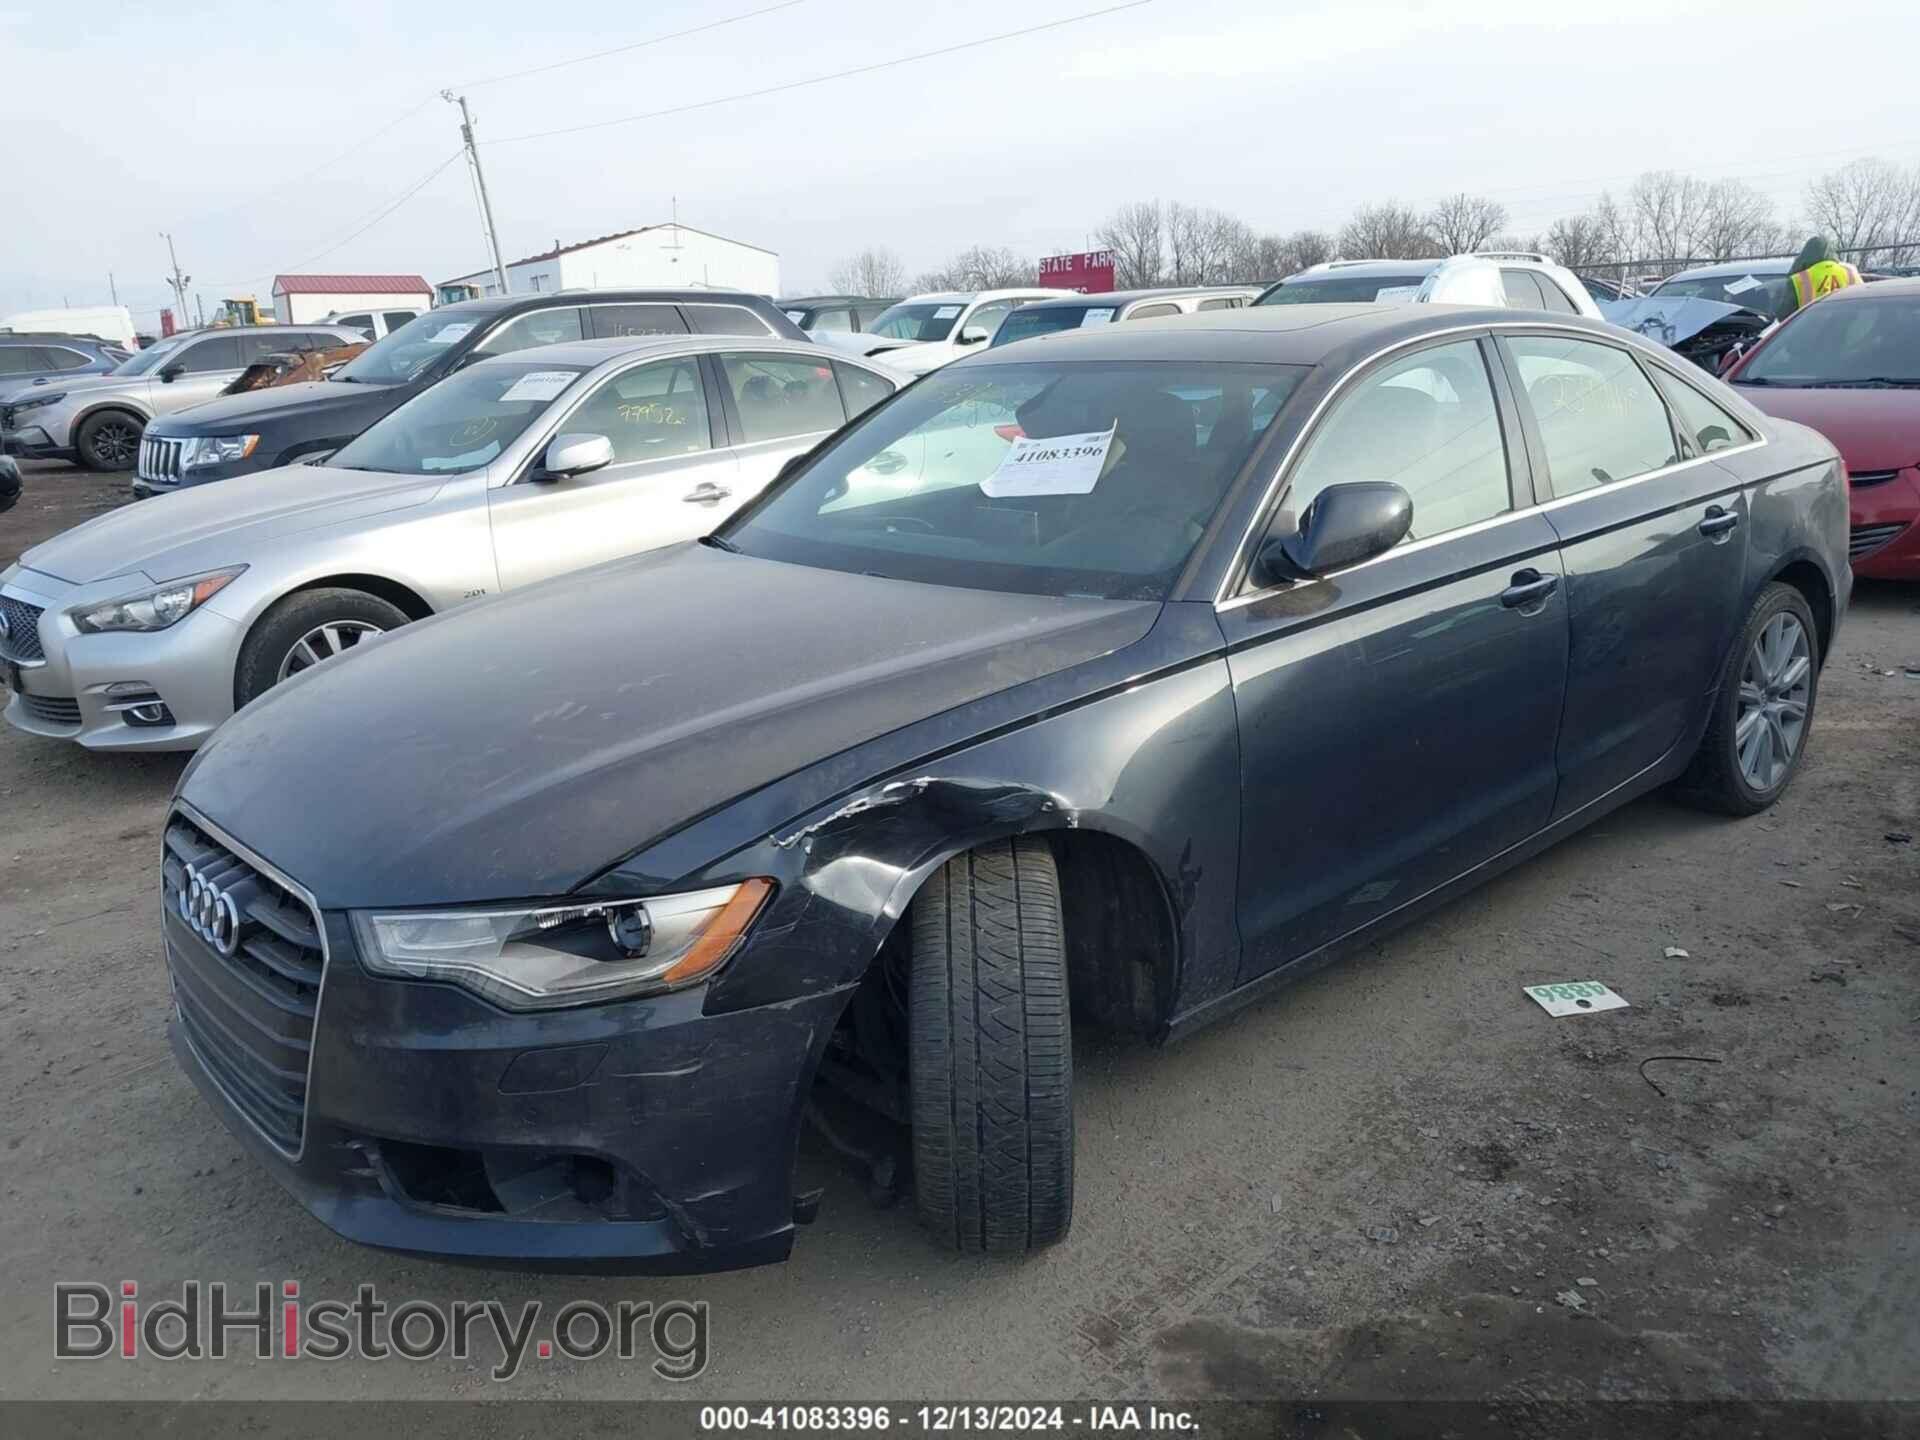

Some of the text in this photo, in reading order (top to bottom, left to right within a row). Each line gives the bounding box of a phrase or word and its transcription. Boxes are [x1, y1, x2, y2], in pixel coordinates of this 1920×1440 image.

[1040, 251, 1114, 274] STATE FARM
[1015, 446, 1103, 463] 41083396
